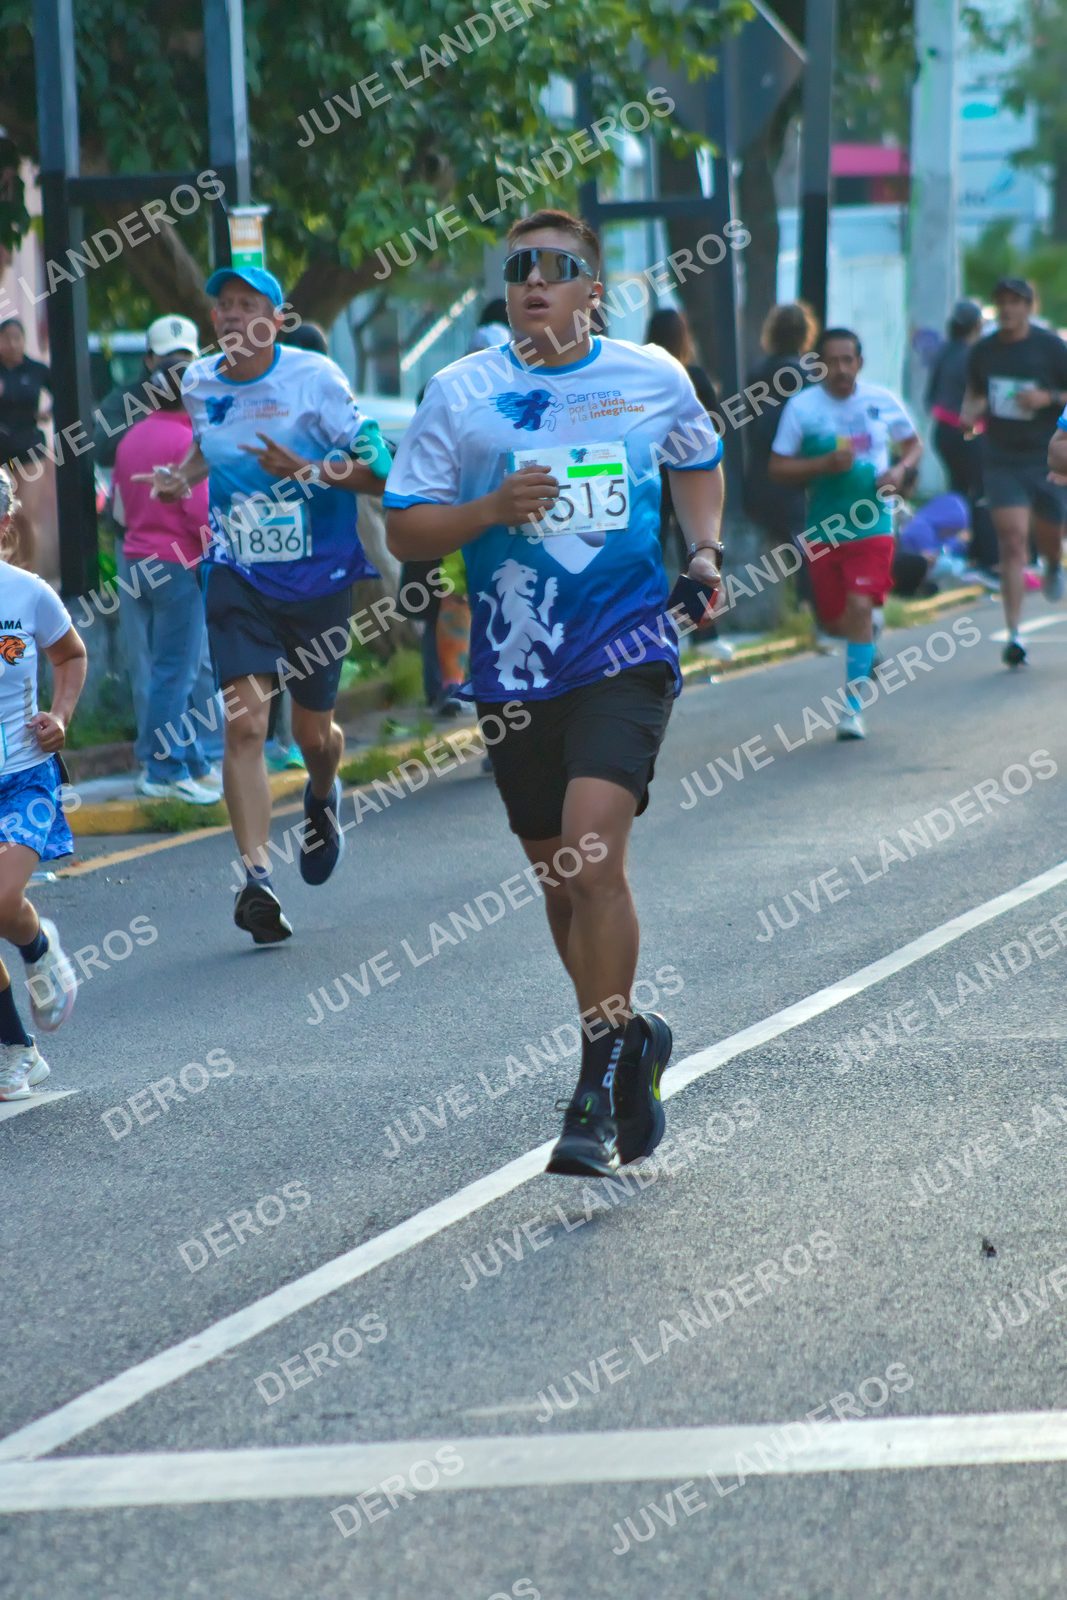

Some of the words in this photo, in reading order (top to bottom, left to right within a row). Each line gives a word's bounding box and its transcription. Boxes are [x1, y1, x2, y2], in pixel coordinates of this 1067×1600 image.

[566, 390, 621, 404] Carrera
[569, 404, 584, 416] por
[588, 402, 598, 411] la
[599, 398, 625, 407] Vida
[570, 415, 576, 425] y
[578, 411, 588, 421] la
[591, 404, 645, 419] Integridad
[551, 479, 626, 522] 515
[235, 527, 301, 555] 1836
